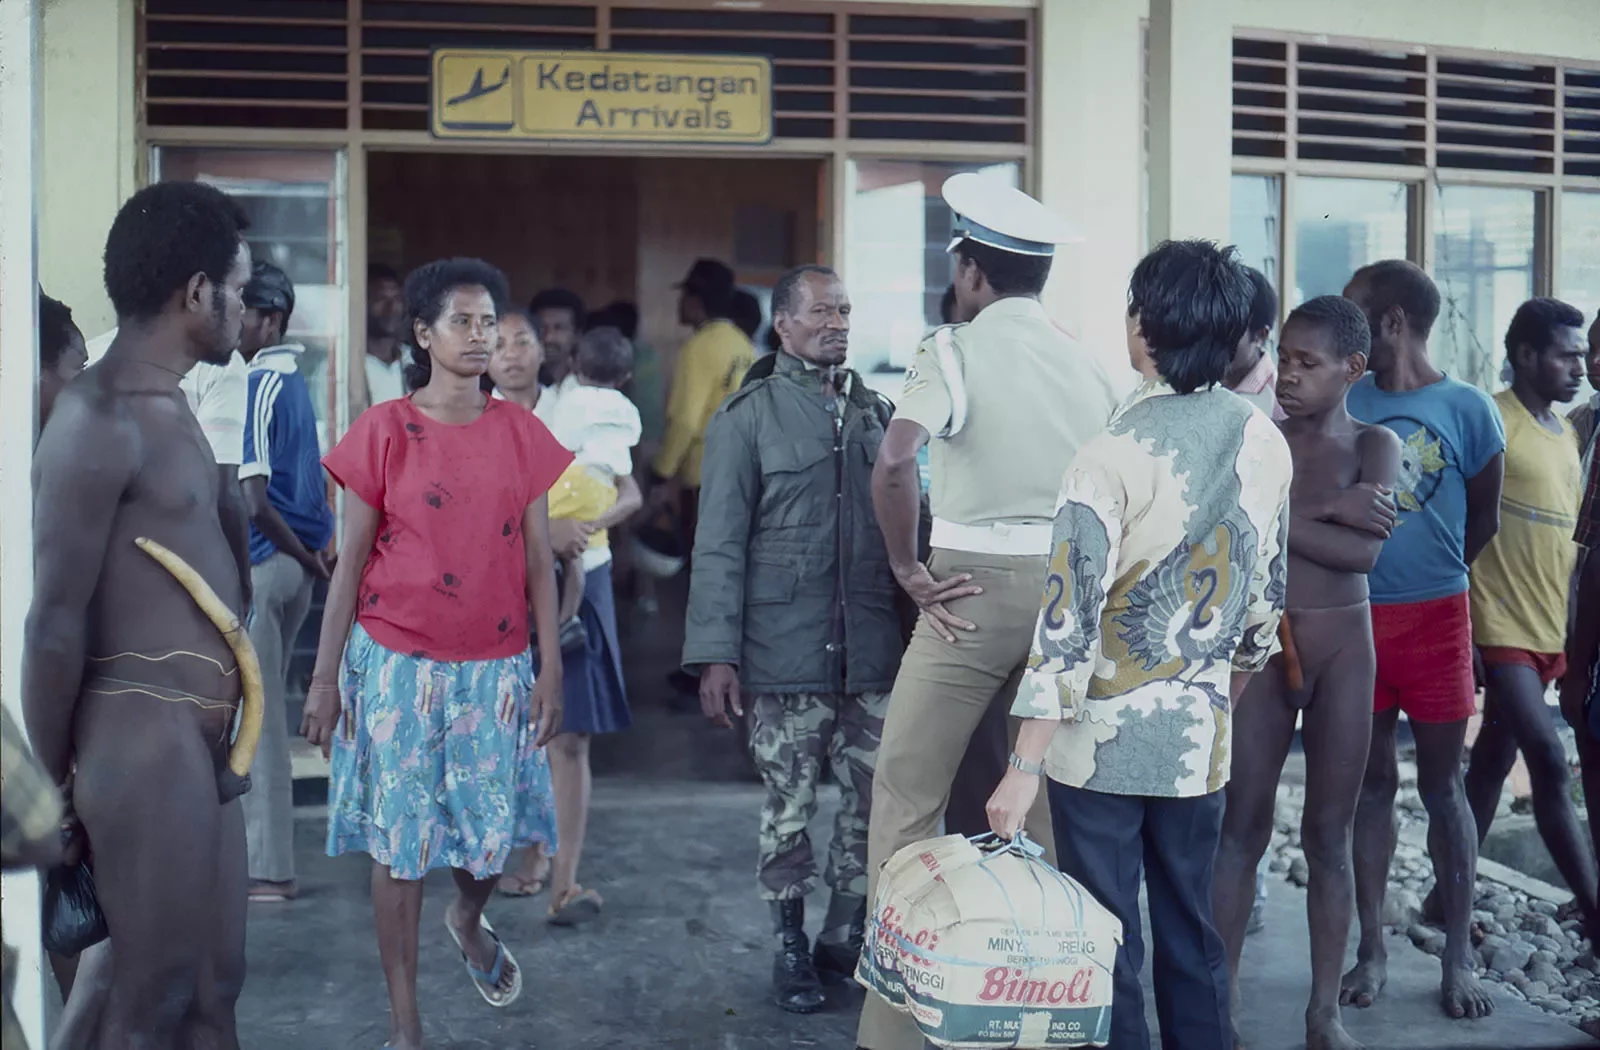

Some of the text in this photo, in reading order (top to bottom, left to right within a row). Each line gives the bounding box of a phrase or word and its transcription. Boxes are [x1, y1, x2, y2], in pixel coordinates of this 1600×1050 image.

[537, 63, 758, 101] Kedatangan
[576, 99, 733, 130] Arrivals
[979, 966, 1092, 1004] Bimoli
[1067, 1021, 1081, 1031] CO
